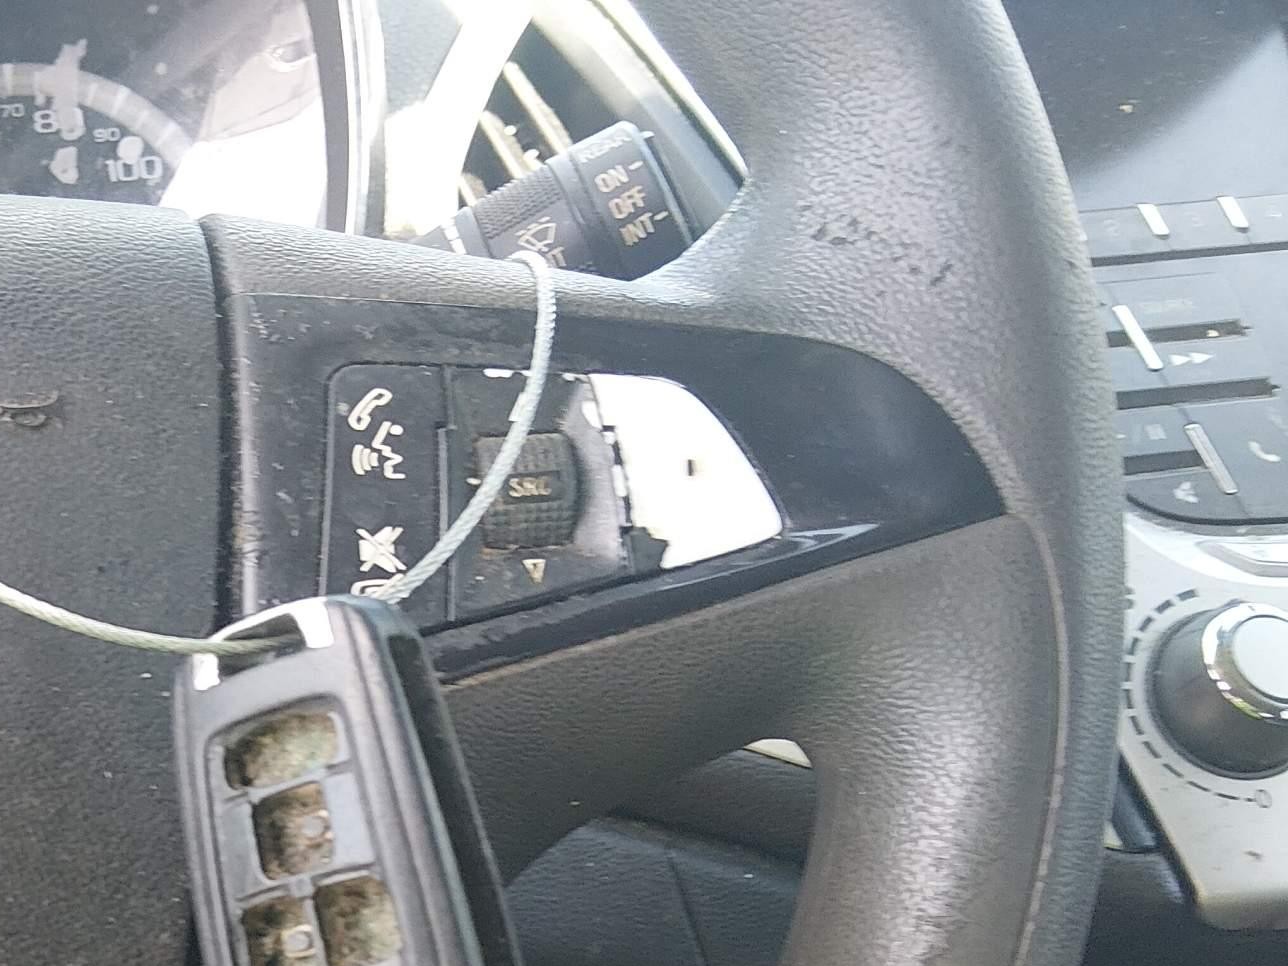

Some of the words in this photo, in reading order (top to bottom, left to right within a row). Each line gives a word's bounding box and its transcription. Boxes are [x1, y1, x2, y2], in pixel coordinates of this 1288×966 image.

[92, 127, 121, 143] 90
[105, 155, 164, 184] 100
[594, 164, 630, 193] ON
[608, 185, 646, 219] OFF
[618, 212, 656, 247] INT
